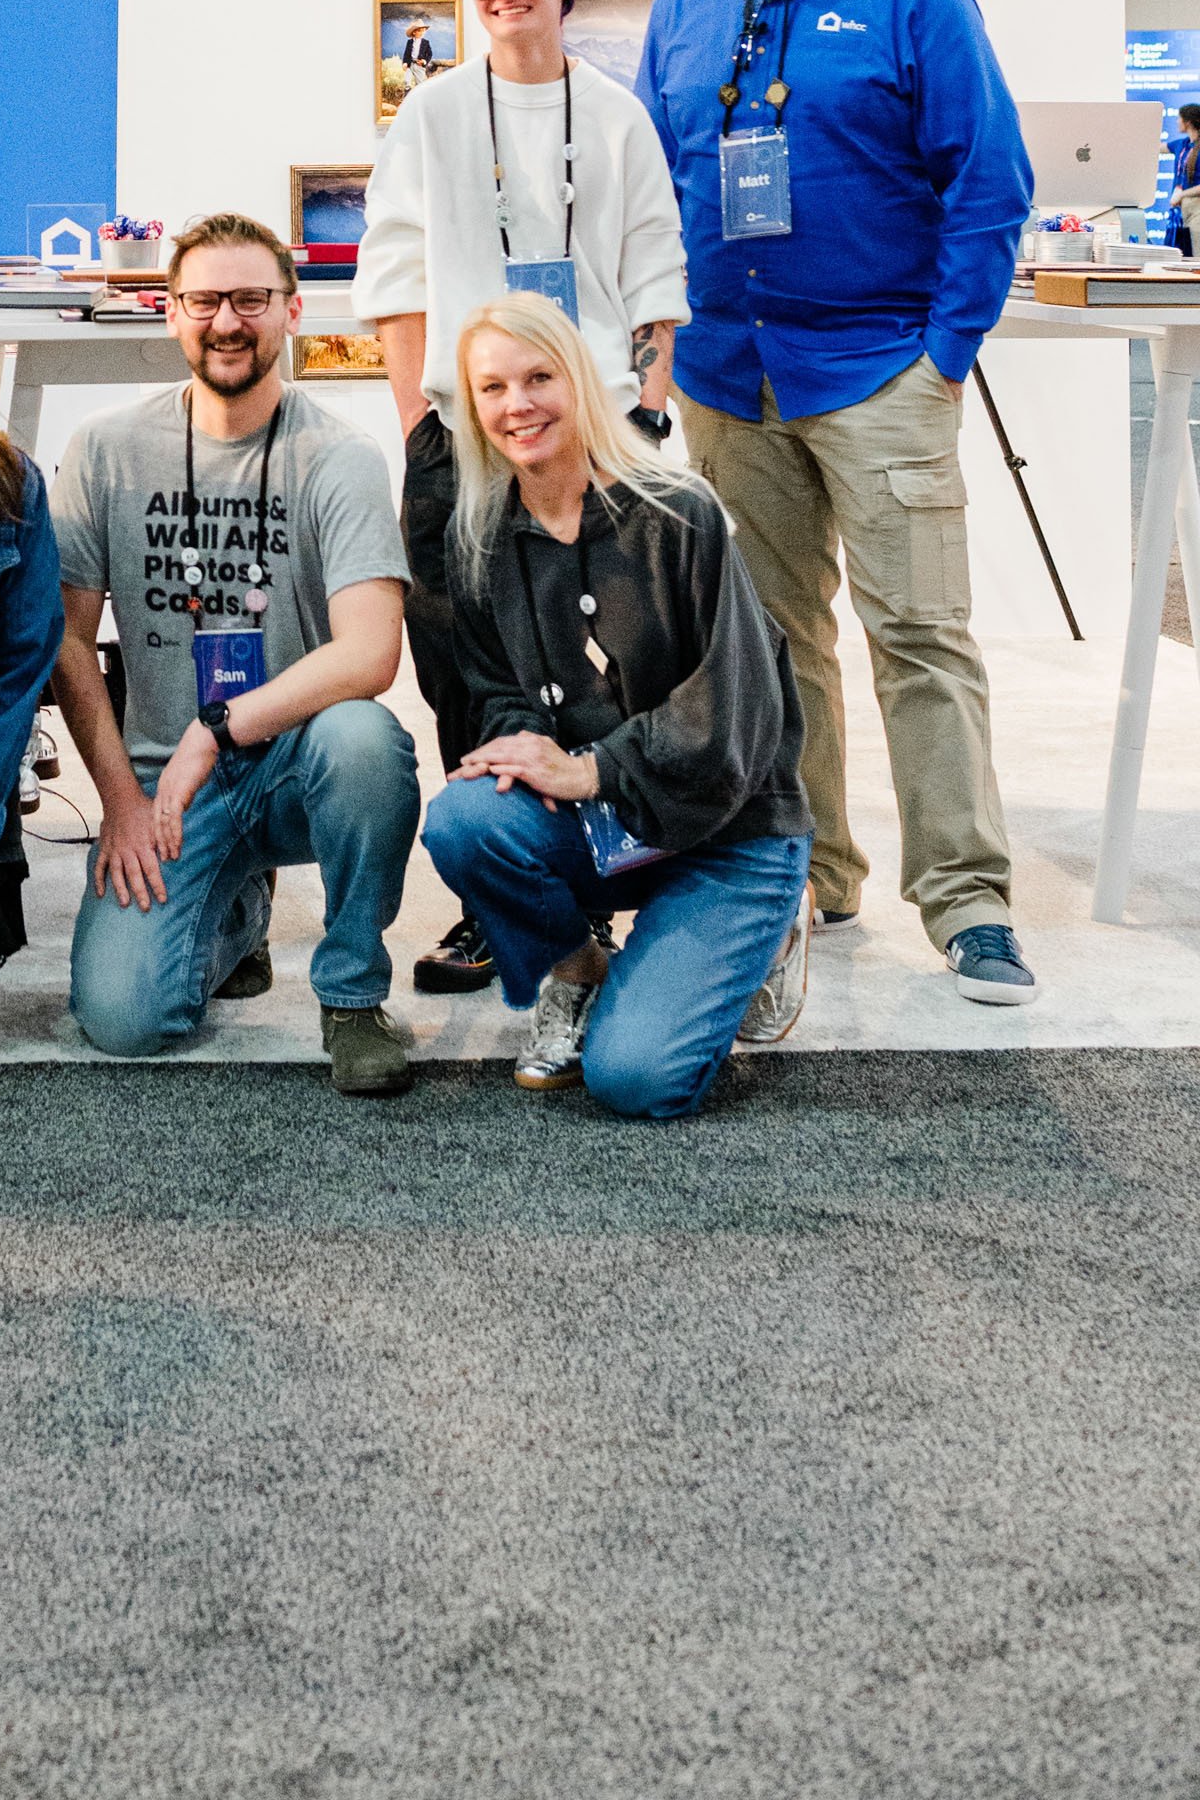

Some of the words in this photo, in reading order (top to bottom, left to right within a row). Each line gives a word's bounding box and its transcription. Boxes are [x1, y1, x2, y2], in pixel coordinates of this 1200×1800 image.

[841, 19, 867, 32] whcc
[738, 174, 771, 188] Matt
[214, 668, 247, 684] Sam
